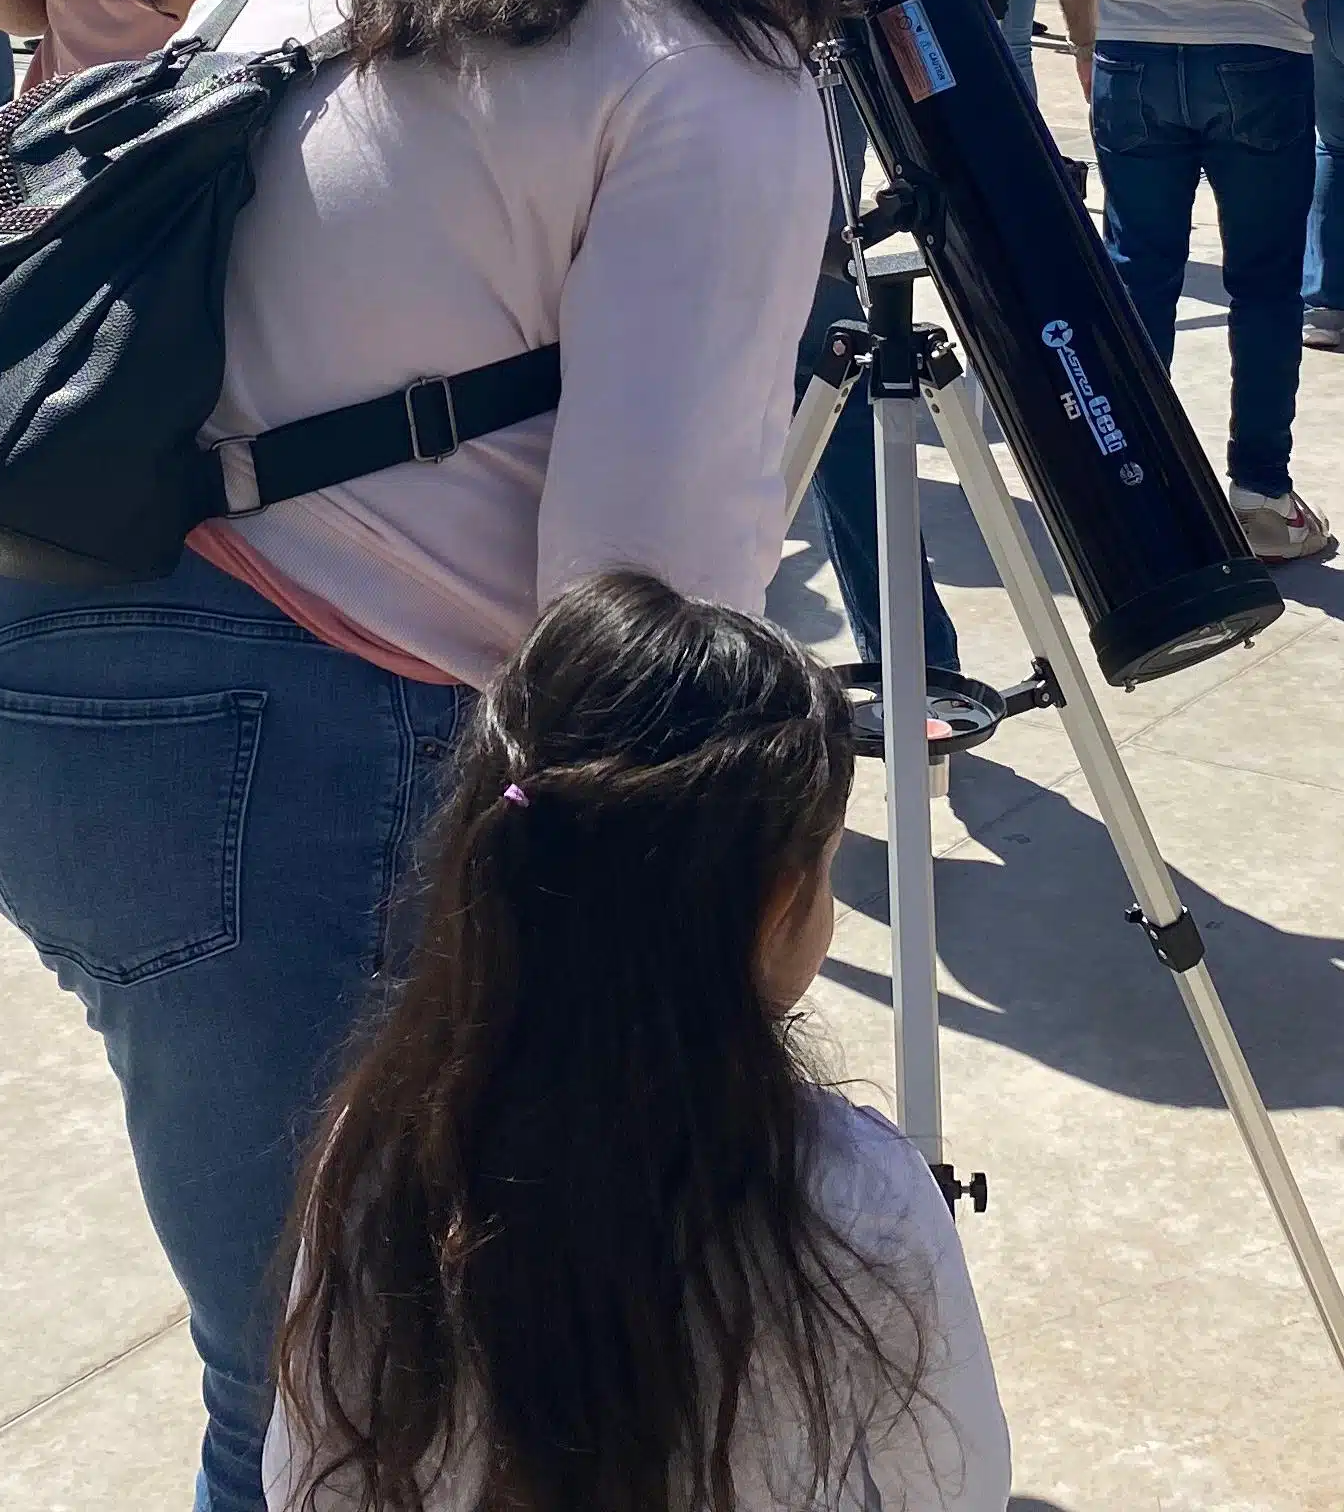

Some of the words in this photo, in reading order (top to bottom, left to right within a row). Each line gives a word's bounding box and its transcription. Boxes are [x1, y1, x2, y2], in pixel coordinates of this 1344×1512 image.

[928, 52, 946, 81] CAUTION
[1060, 390, 1082, 421] HD
[1062, 345, 1094, 397] ASTRO
[1088, 395, 1128, 454] Ceti
